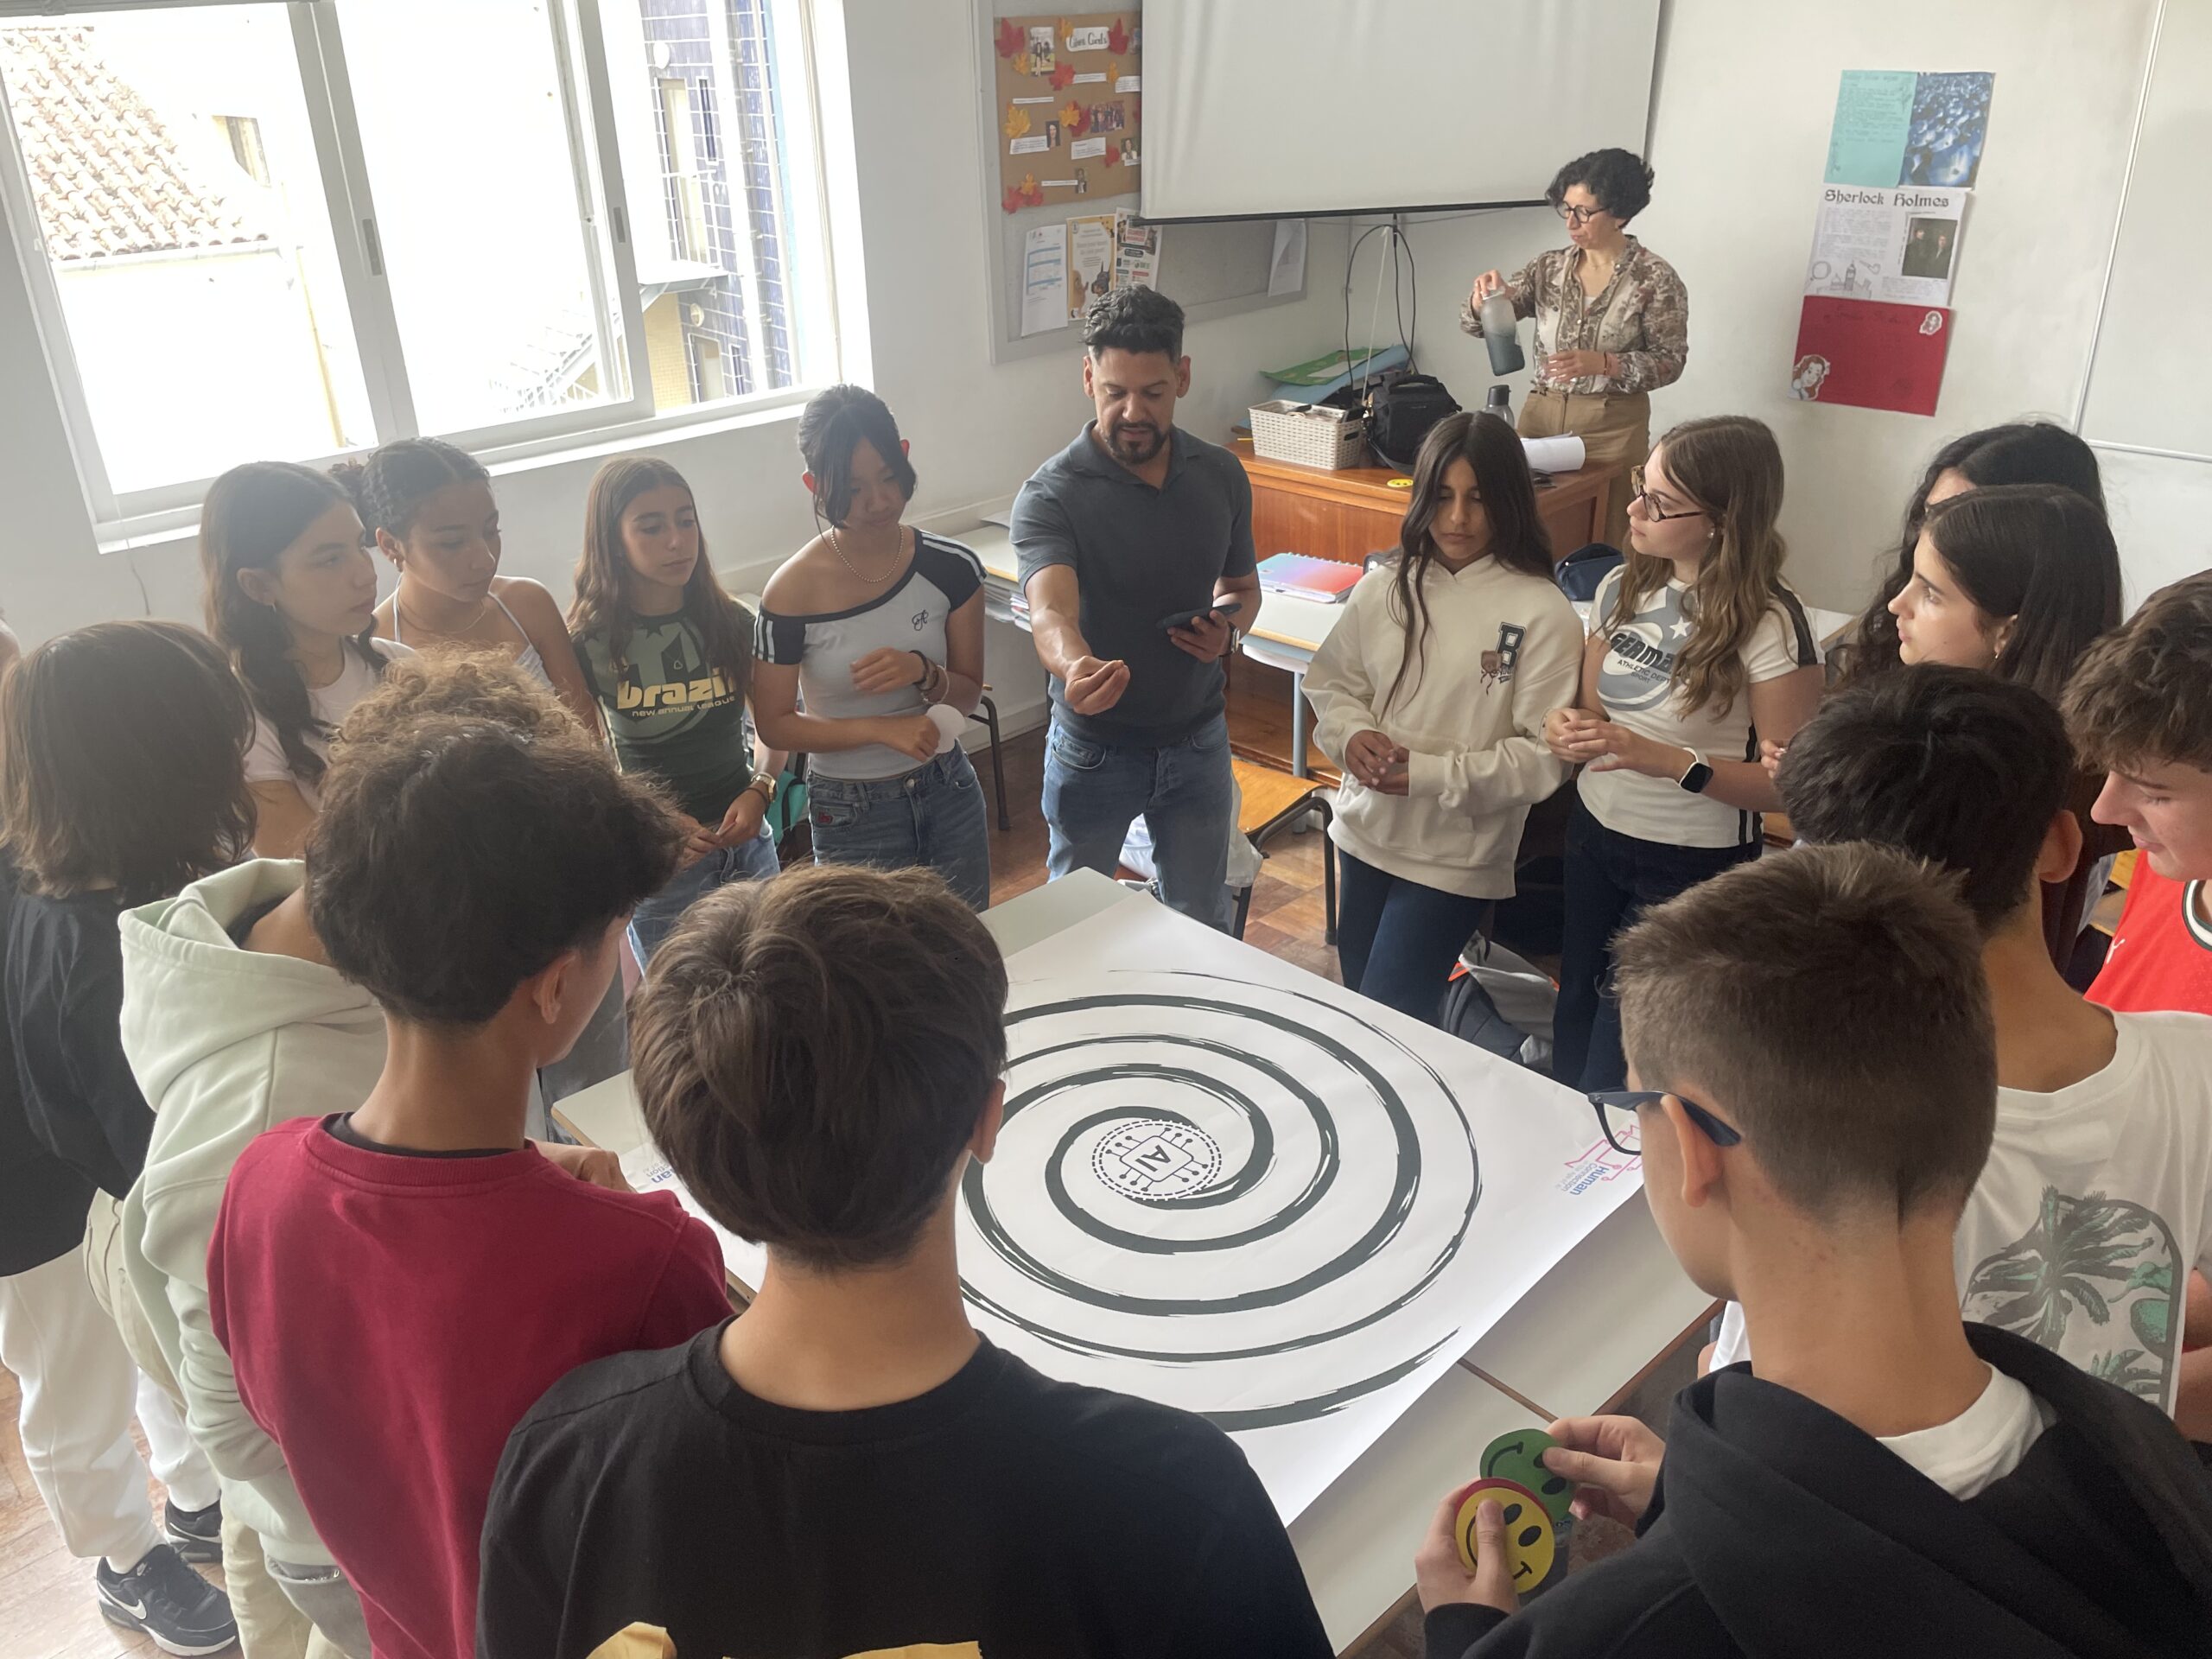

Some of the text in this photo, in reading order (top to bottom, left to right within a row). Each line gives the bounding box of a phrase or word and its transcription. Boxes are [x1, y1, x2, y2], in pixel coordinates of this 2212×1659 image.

[1824, 188, 1949, 207] Sherlock Holmes
[1617, 658, 1650, 675] ATHLETIC
[658, 705, 694, 714] annual
[1135, 1144, 1172, 1173] AI
[1569, 1166, 1610, 1195] Human
